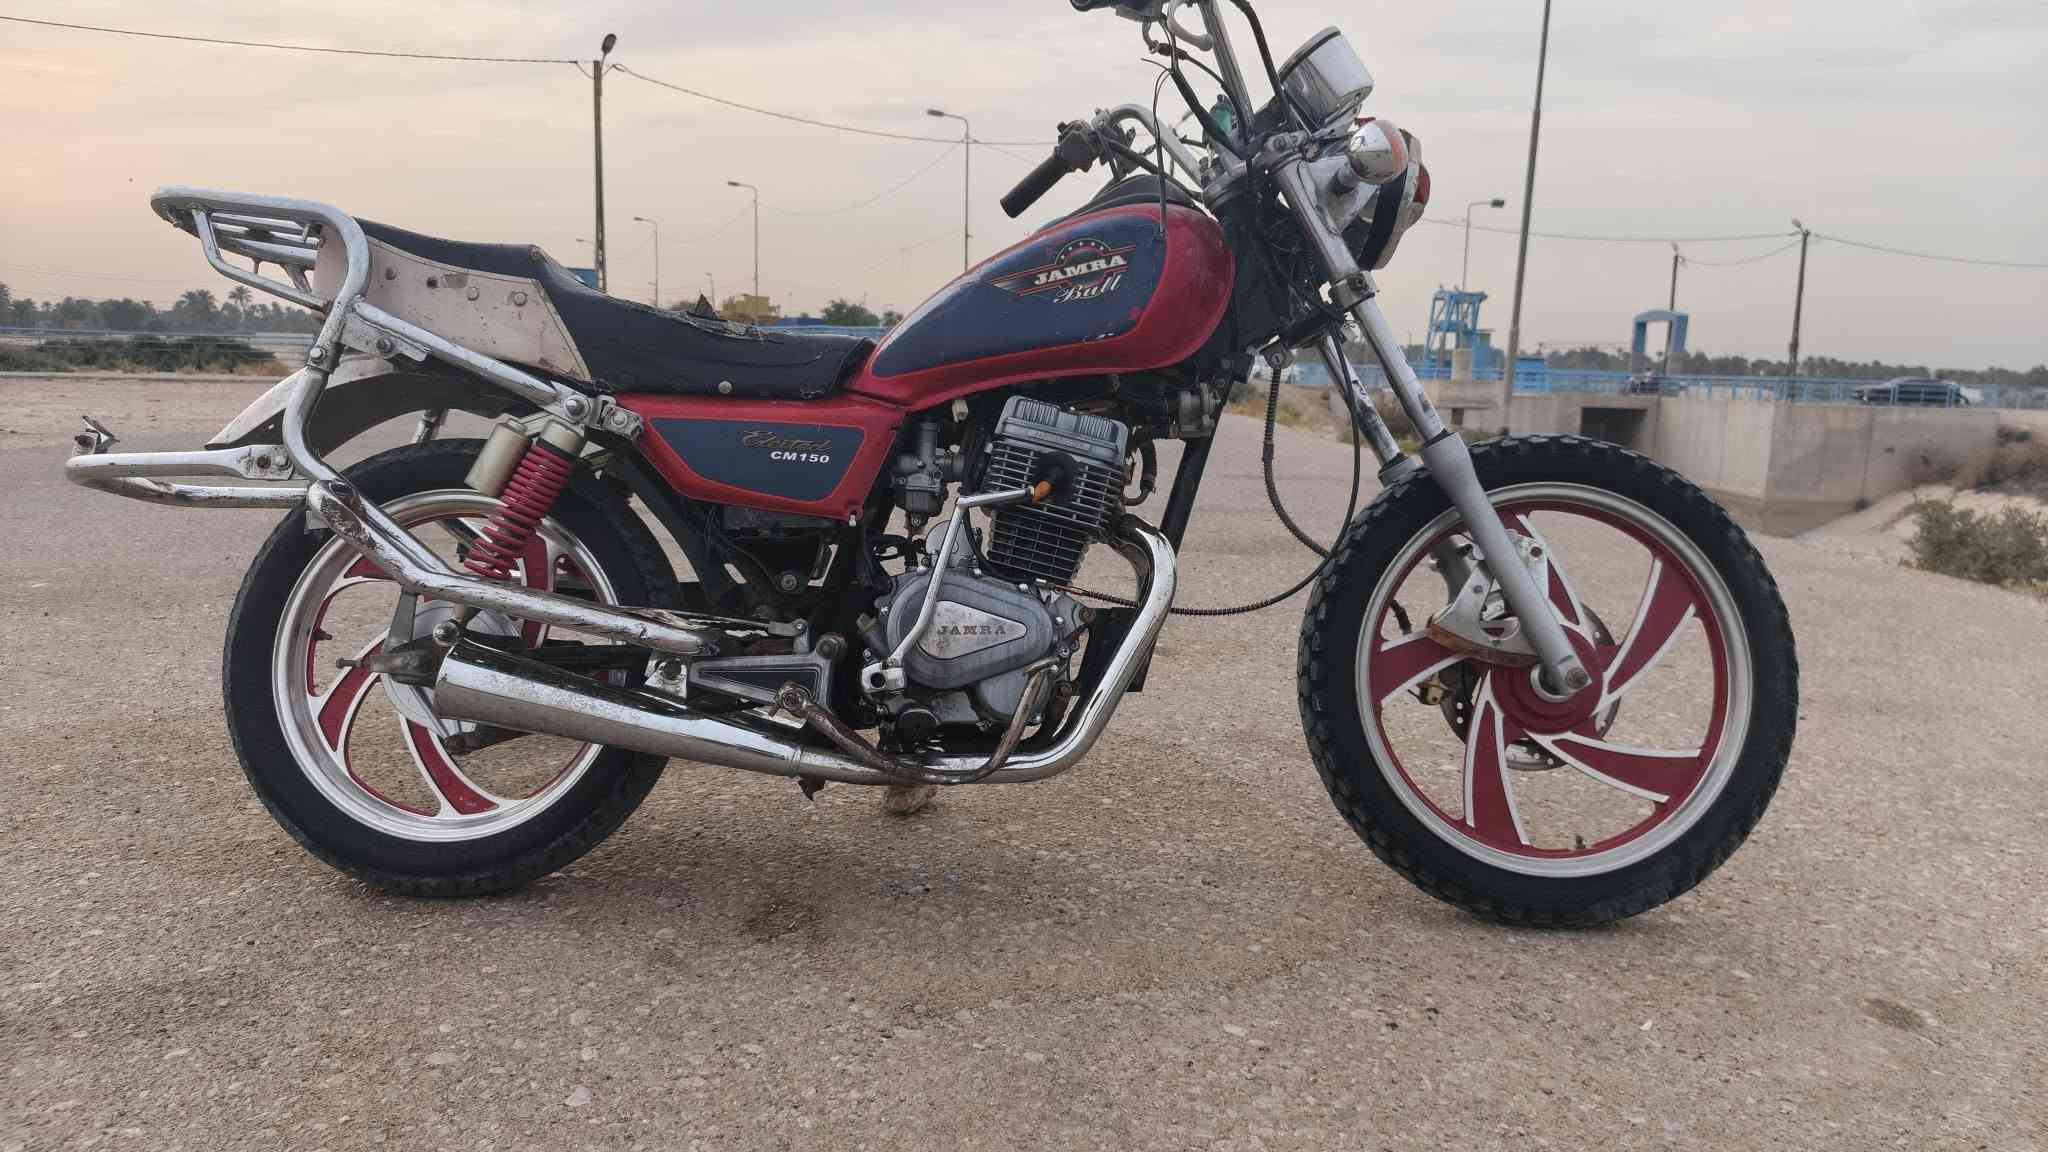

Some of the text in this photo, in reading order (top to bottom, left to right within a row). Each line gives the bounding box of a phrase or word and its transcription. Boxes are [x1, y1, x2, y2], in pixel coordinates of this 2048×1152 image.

[1034, 255, 1128, 285] JAMRA
[1053, 273, 1122, 303] Bull
[770, 451, 830, 463] CM150
[937, 625, 1007, 635] JAMRA
